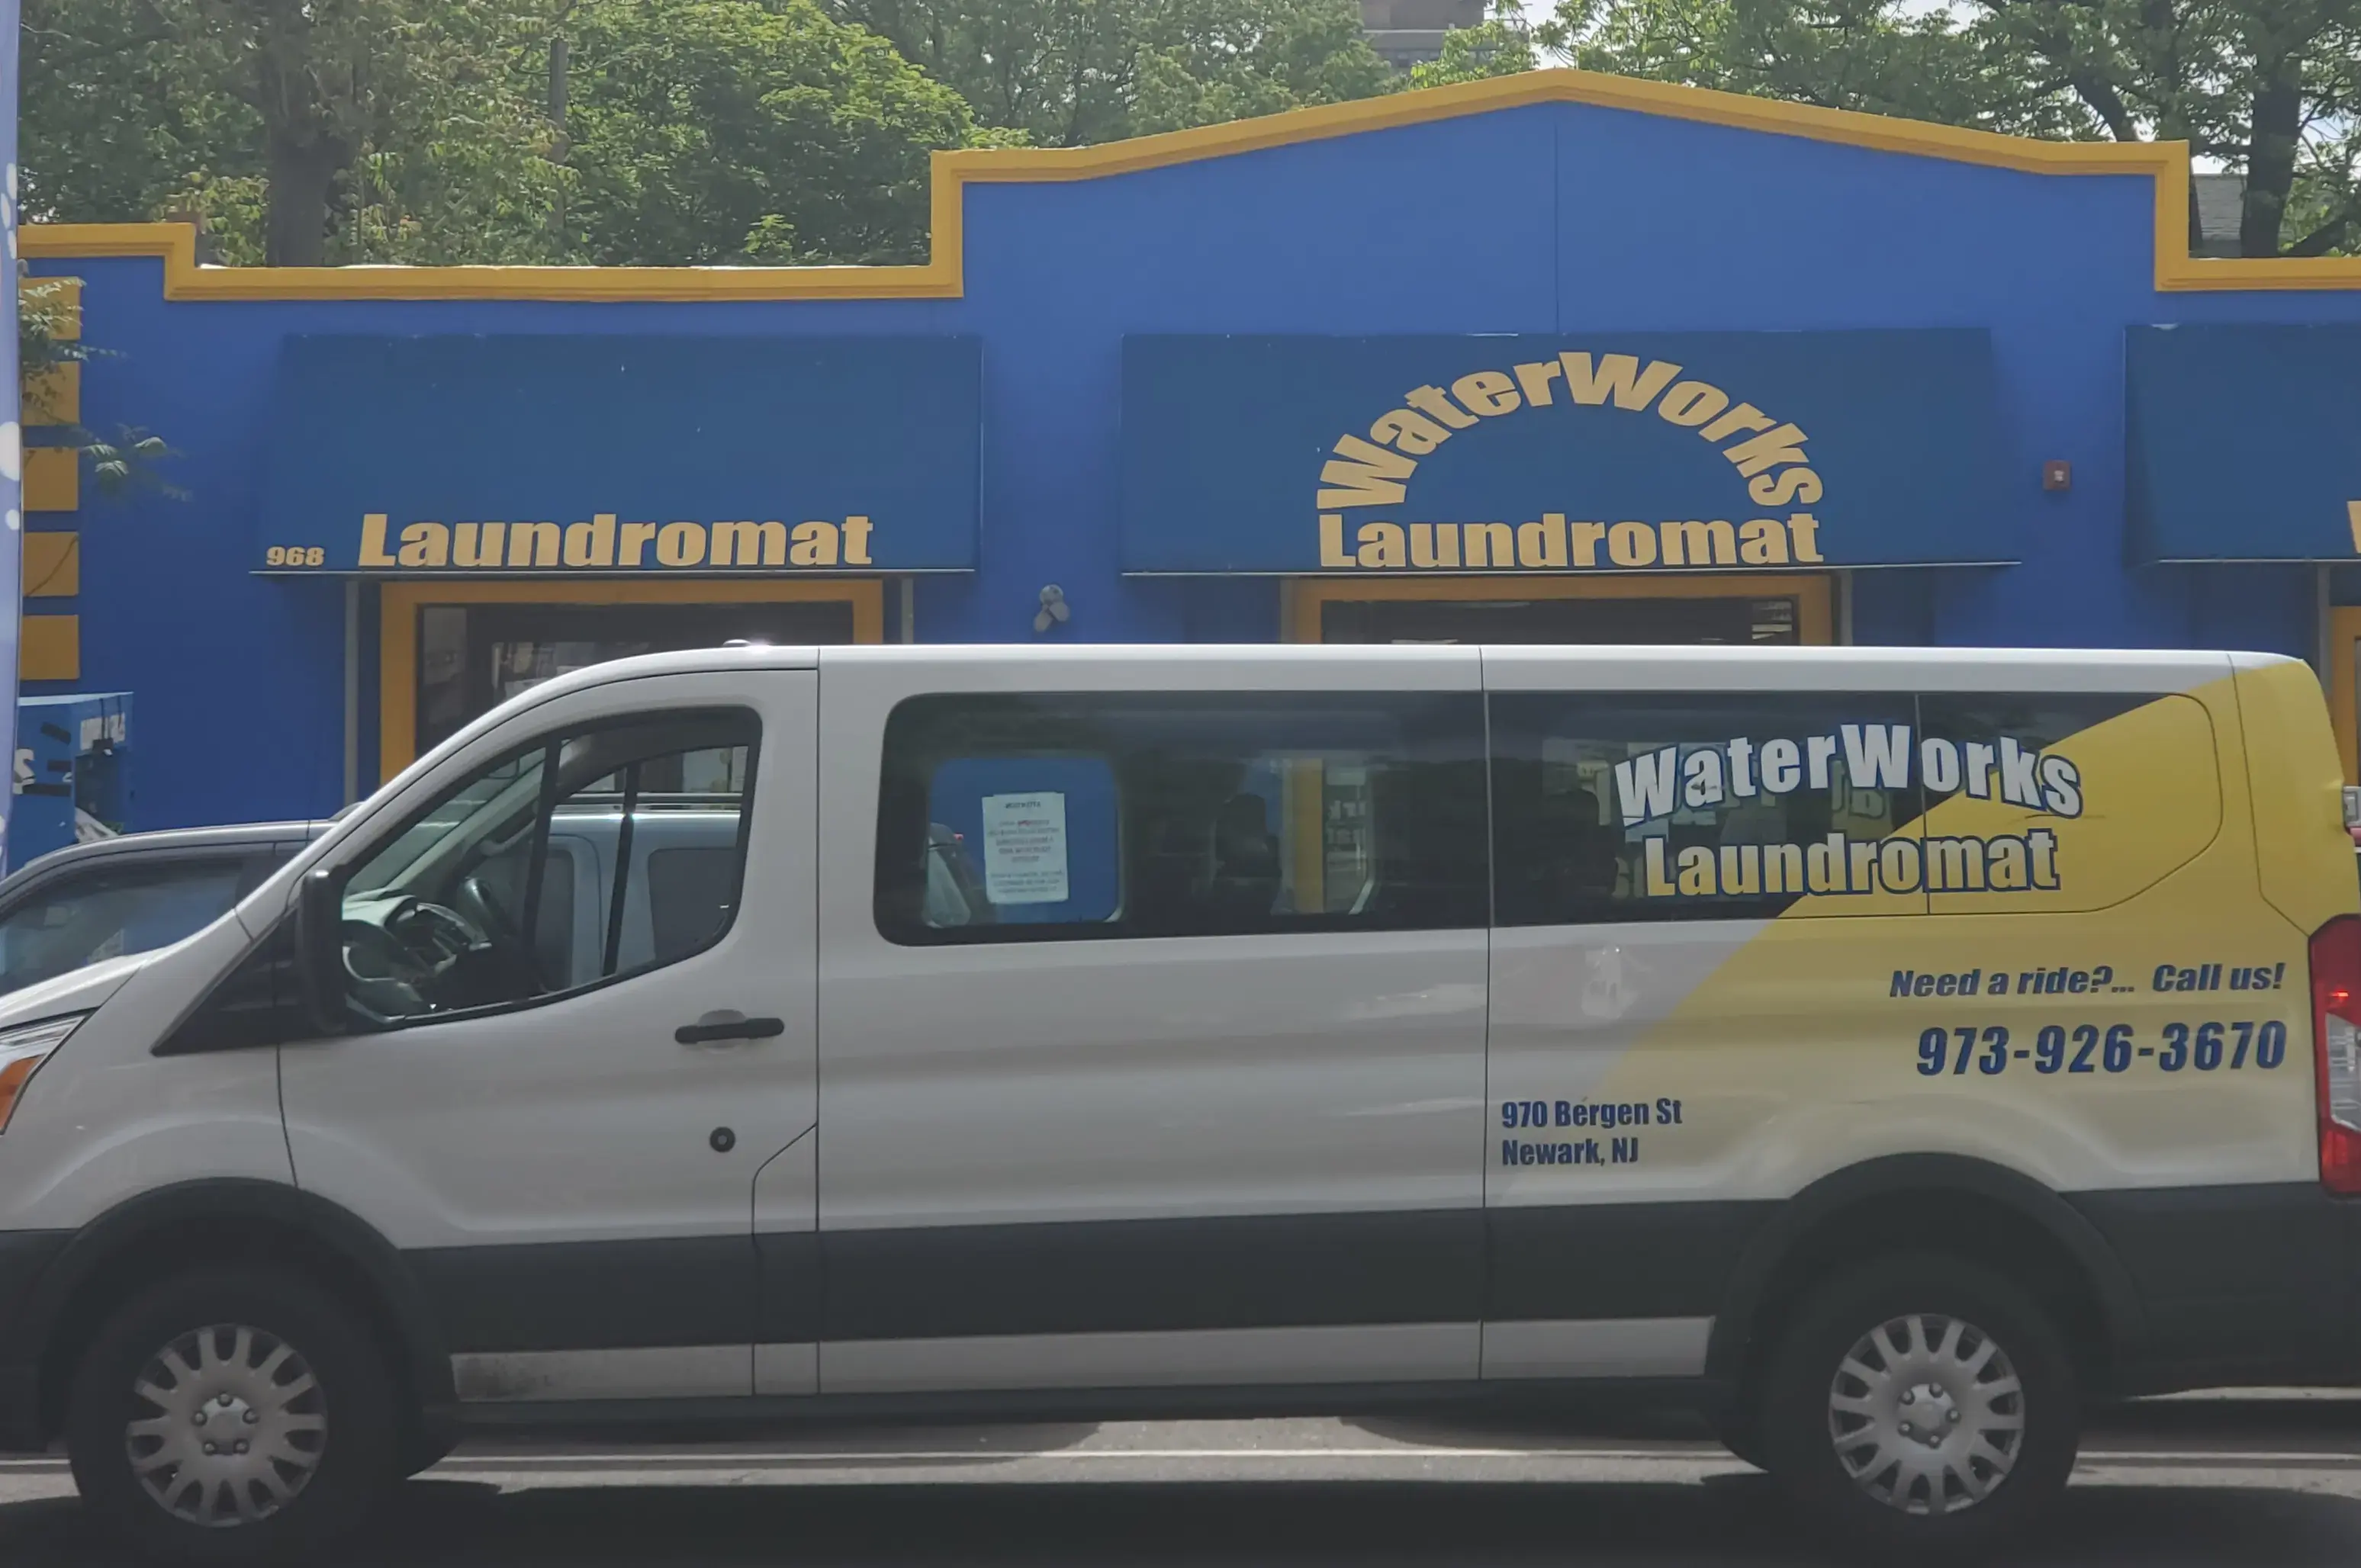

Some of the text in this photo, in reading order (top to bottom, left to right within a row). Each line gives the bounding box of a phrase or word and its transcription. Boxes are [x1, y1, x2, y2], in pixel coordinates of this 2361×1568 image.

[1317, 352, 1823, 509] WaterWorks
[265, 546, 325, 567] 968
[358, 513, 873, 567] Laundromat
[1318, 512, 1824, 567] Laundromat
[1613, 722, 2083, 827] WaterWorks
[1643, 829, 2060, 897] Laundromat
[1890, 969, 1981, 998] Need
[1987, 971, 2009, 995] a
[2152, 962, 2223, 992] Call
[2229, 962, 2286, 991] us!
[1915, 1020, 2287, 1076] 973-926-3670
[1501, 1097, 1684, 1129] 970 Bergen St
[1502, 1137, 1639, 1167] Newark, NJ
